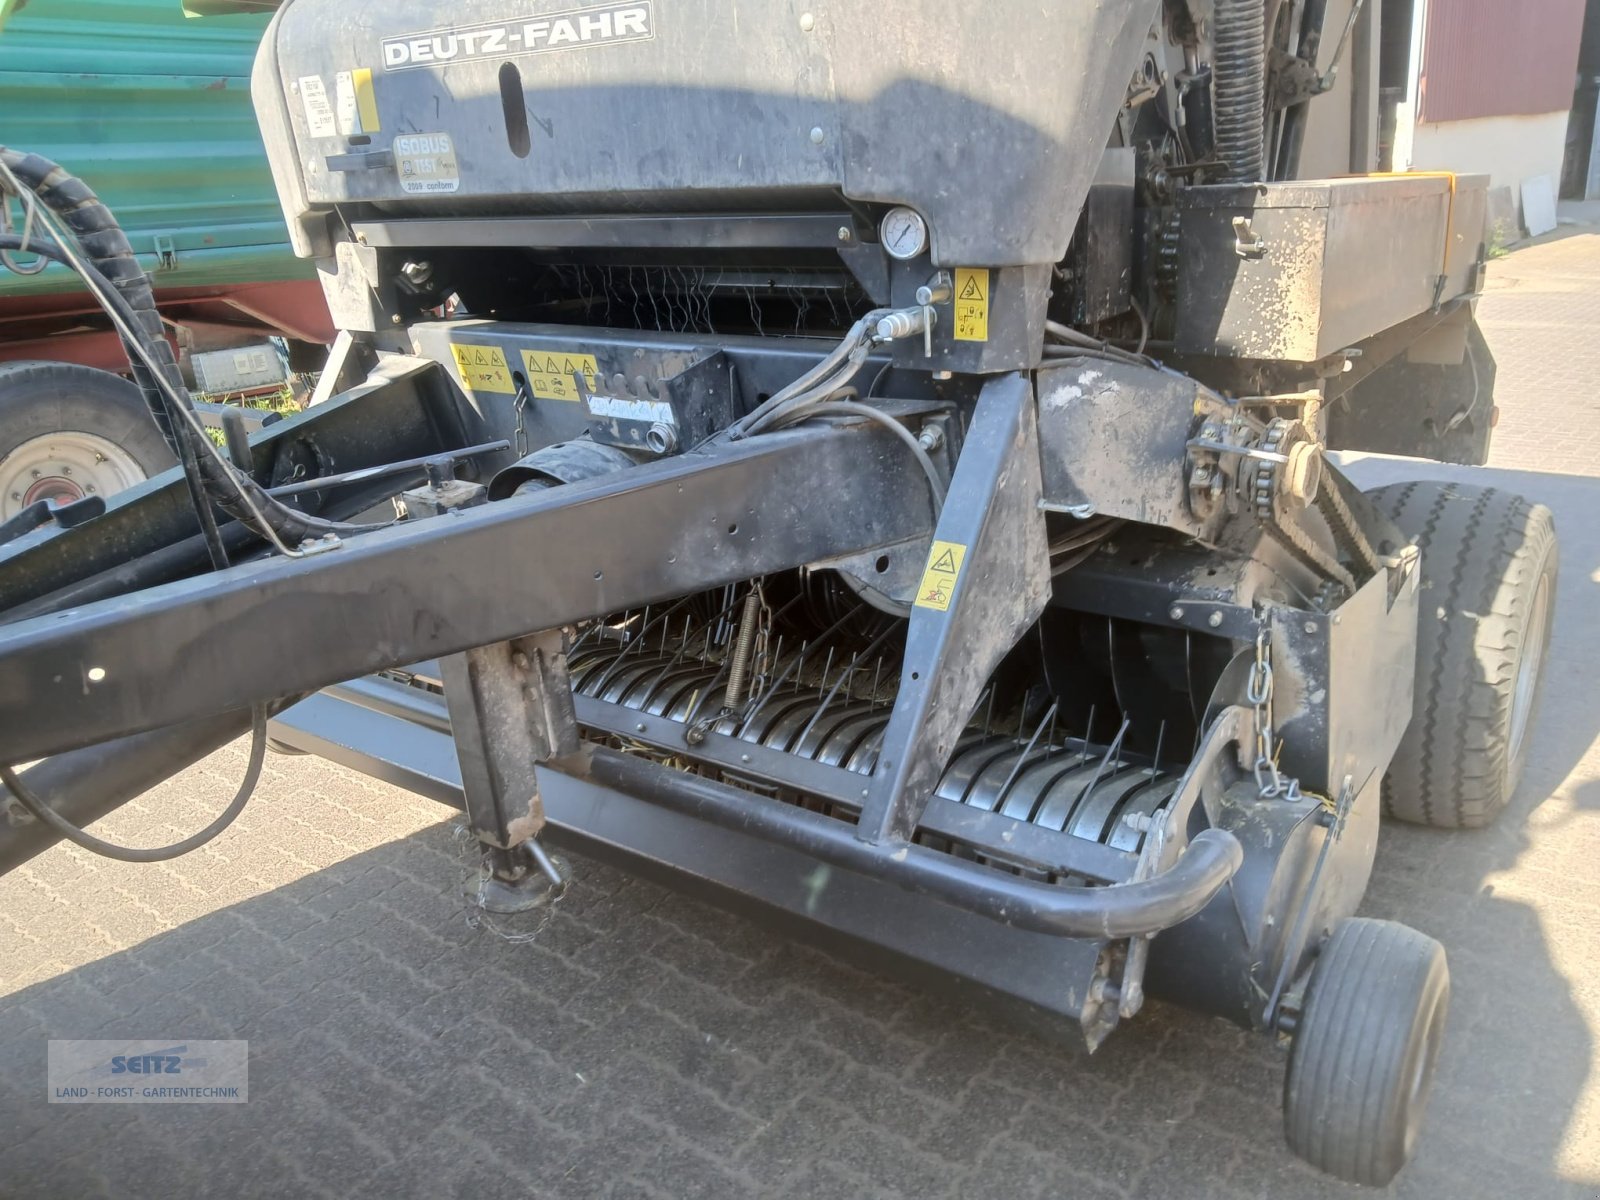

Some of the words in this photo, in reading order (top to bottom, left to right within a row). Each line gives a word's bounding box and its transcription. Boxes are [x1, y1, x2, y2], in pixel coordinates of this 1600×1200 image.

[384, 7, 649, 67] DEUTZ-FAHR
[396, 136, 450, 156] ISOBUS
[414, 158, 438, 173] TEST
[426, 180, 455, 190] conform
